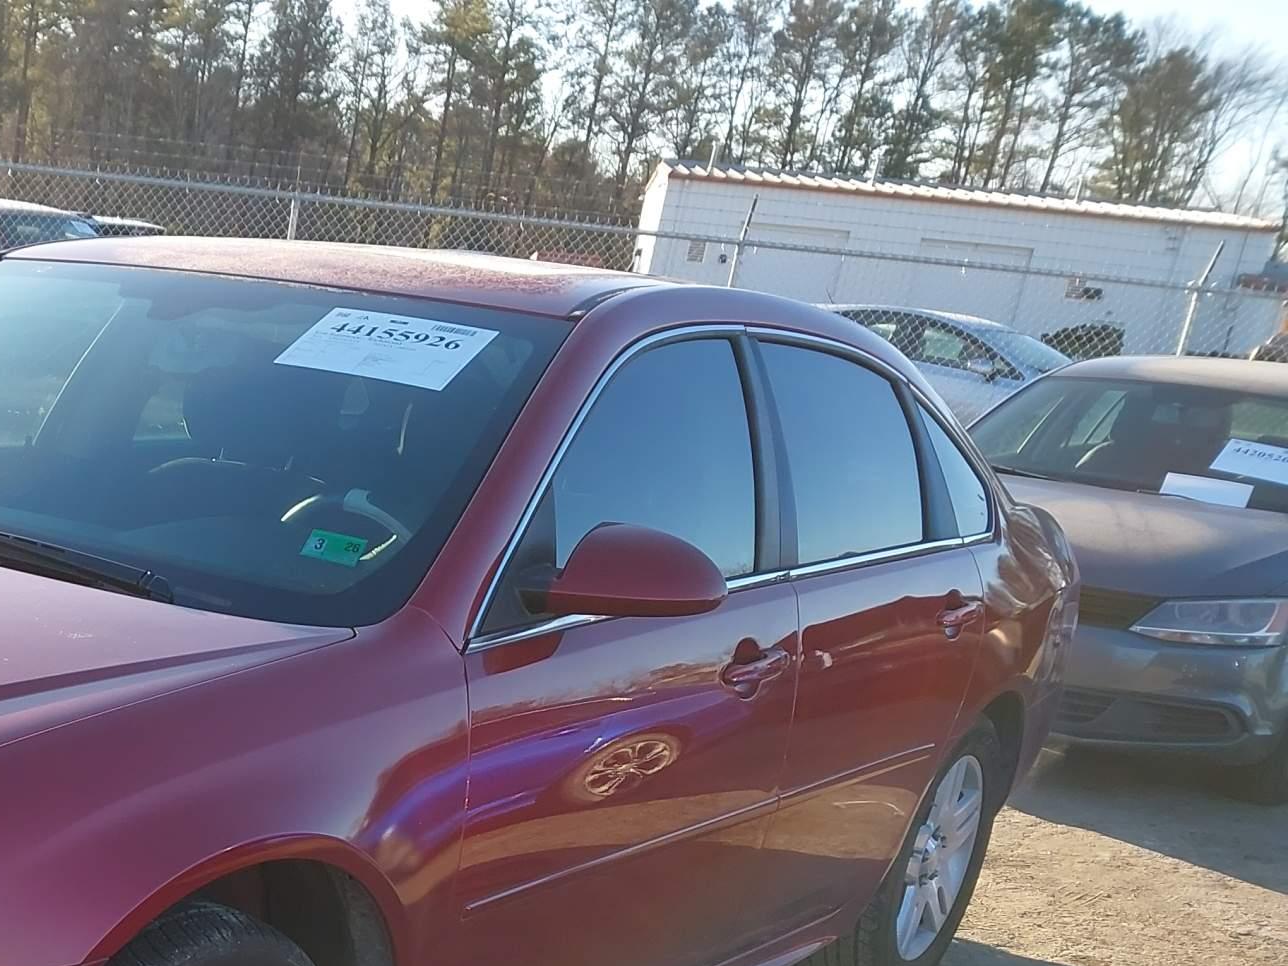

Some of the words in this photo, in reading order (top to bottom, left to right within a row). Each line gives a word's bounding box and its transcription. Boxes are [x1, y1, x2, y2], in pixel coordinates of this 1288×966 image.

[330, 322, 464, 350] 44155926
[314, 538, 325, 550] 3
[344, 542, 361, 552] 26
